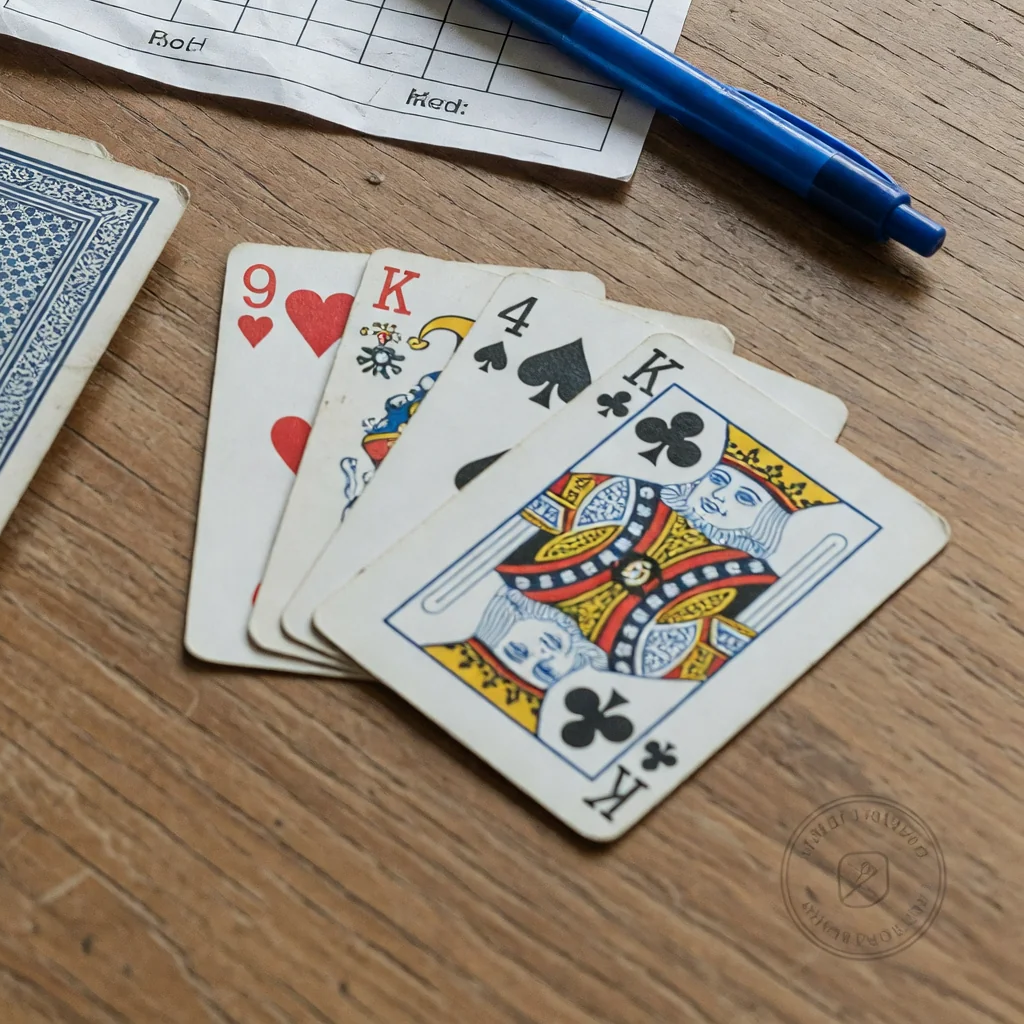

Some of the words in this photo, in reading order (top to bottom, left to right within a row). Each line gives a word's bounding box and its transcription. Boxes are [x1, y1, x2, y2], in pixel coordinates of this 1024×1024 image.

[242, 263, 277, 309] 9
[372, 266, 421, 316] K
[497, 296, 538, 338] 4
[622, 348, 685, 397] K
[583, 765, 649, 822] K
